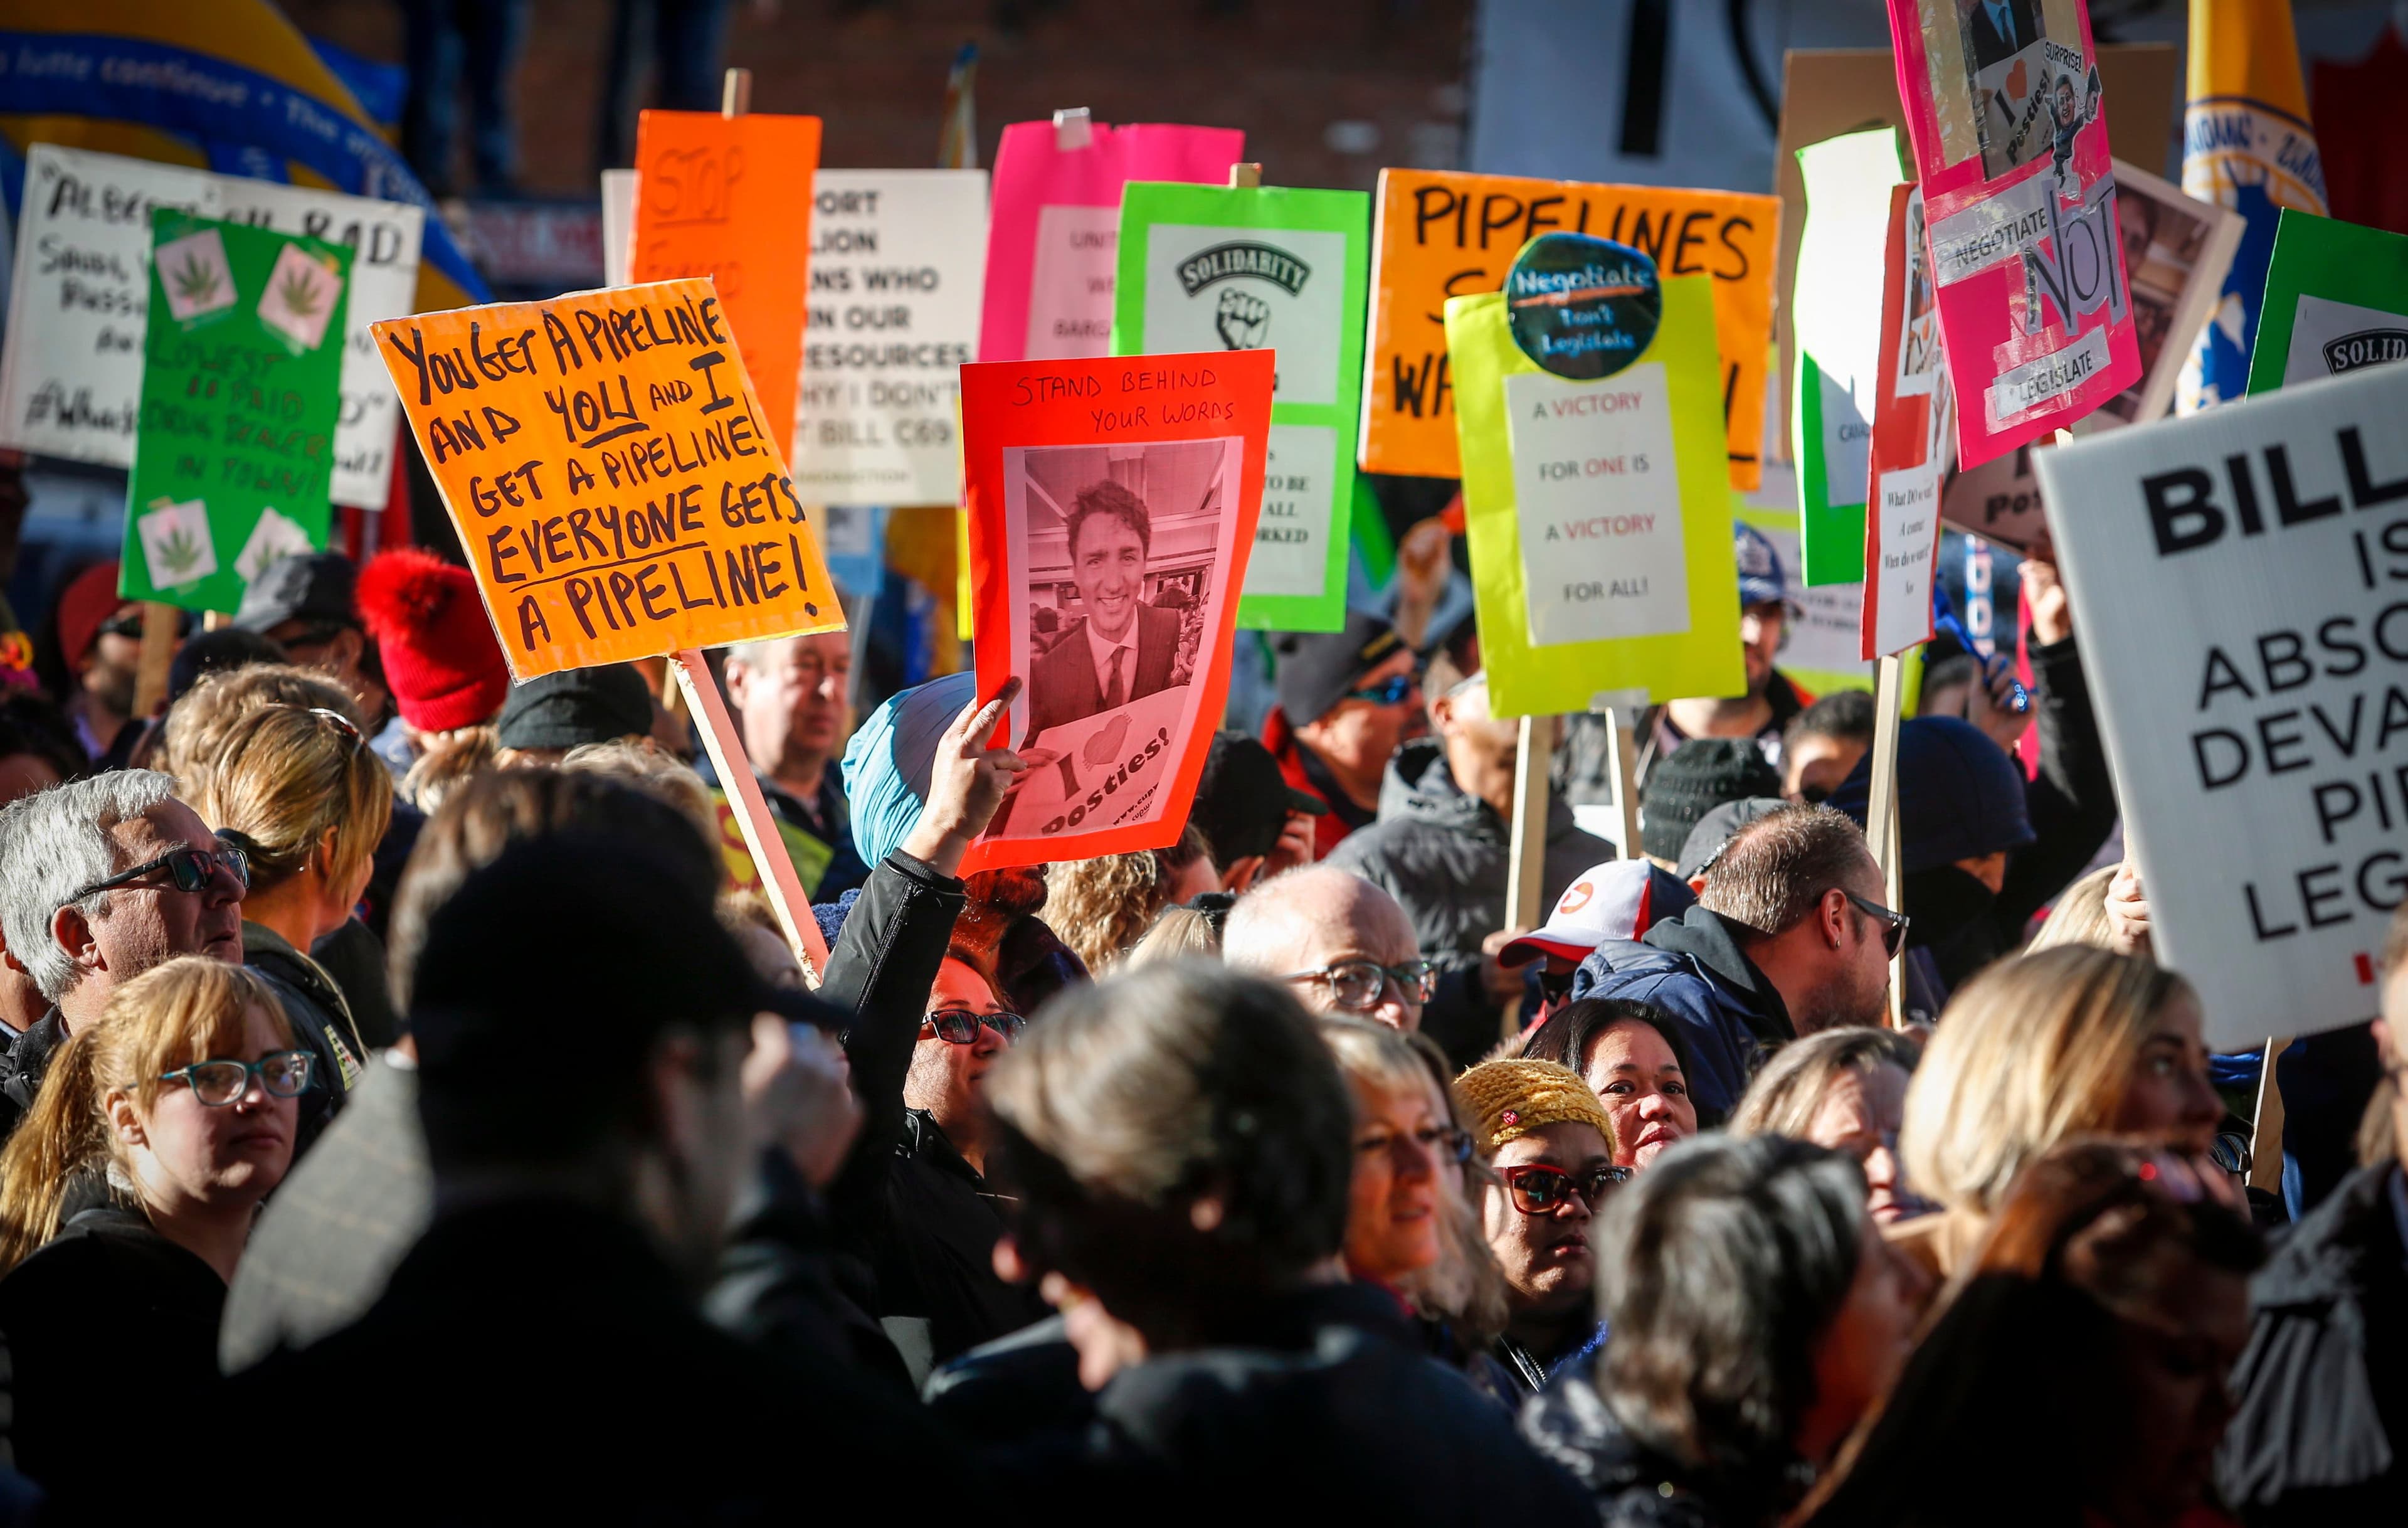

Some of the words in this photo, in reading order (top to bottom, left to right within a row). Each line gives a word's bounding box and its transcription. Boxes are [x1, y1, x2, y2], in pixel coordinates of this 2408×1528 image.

[2046, 41, 2081, 73] SURPRISE!
[1995, 88, 2016, 127] I
[650, 144, 744, 217] STOP
[1413, 186, 1753, 280] PIPELINES
[1956, 208, 2047, 268] NEGOTIATE
[1181, 241, 1308, 294] SOLIDARITY
[2025, 186, 2117, 329] NOT
[862, 267, 940, 291] WHO
[1516, 262, 1652, 299] Negotiate
[845, 305, 912, 331] OUR
[1559, 304, 1613, 327] Don't
[390, 324, 477, 405] YOU
[470, 322, 537, 381] GET
[542, 309, 582, 376] A
[577, 295, 727, 363] PIPELINE
[1541, 329, 1635, 358] Legislate
[868, 379, 961, 406] DON'T
[1012, 375, 1101, 406] STAND
[1121, 369, 1216, 393] BEHIND
[2019, 349, 2092, 401] LEGISLATE
[430, 405, 520, 463] AND
[544, 375, 637, 442] YOU
[650, 379, 692, 411] AND
[690, 351, 734, 415] I
[1091, 406, 1149, 433] YOUR
[1163, 401, 1233, 425] WORDS
[1533, 402, 1548, 420] A
[1551, 391, 1642, 418] VICTORY
[820, 418, 885, 447] BILL
[893, 418, 953, 447] C69
[470, 460, 543, 517] GET
[568, 459, 594, 496] A
[601, 391, 768, 488] PIPELINE!
[1539, 462, 1580, 481] FOR
[1585, 456, 1627, 477] ONE
[1633, 454, 1650, 474] IS
[1287, 475, 1310, 492] BE
[2141, 424, 2408, 558] BILL
[1267, 501, 1299, 517] ALL
[1545, 524, 1560, 541] A
[1564, 514, 1656, 539] VICTORY
[487, 484, 705, 583] EVERYONE
[721, 476, 806, 527] GETS
[2353, 519, 2408, 591] IS
[517, 596, 551, 651] A
[564, 533, 818, 640] PIPELINE!
[1563, 583, 1603, 603] FOR
[1610, 577, 1649, 597] ALL!
[1057, 751, 1081, 802] I
